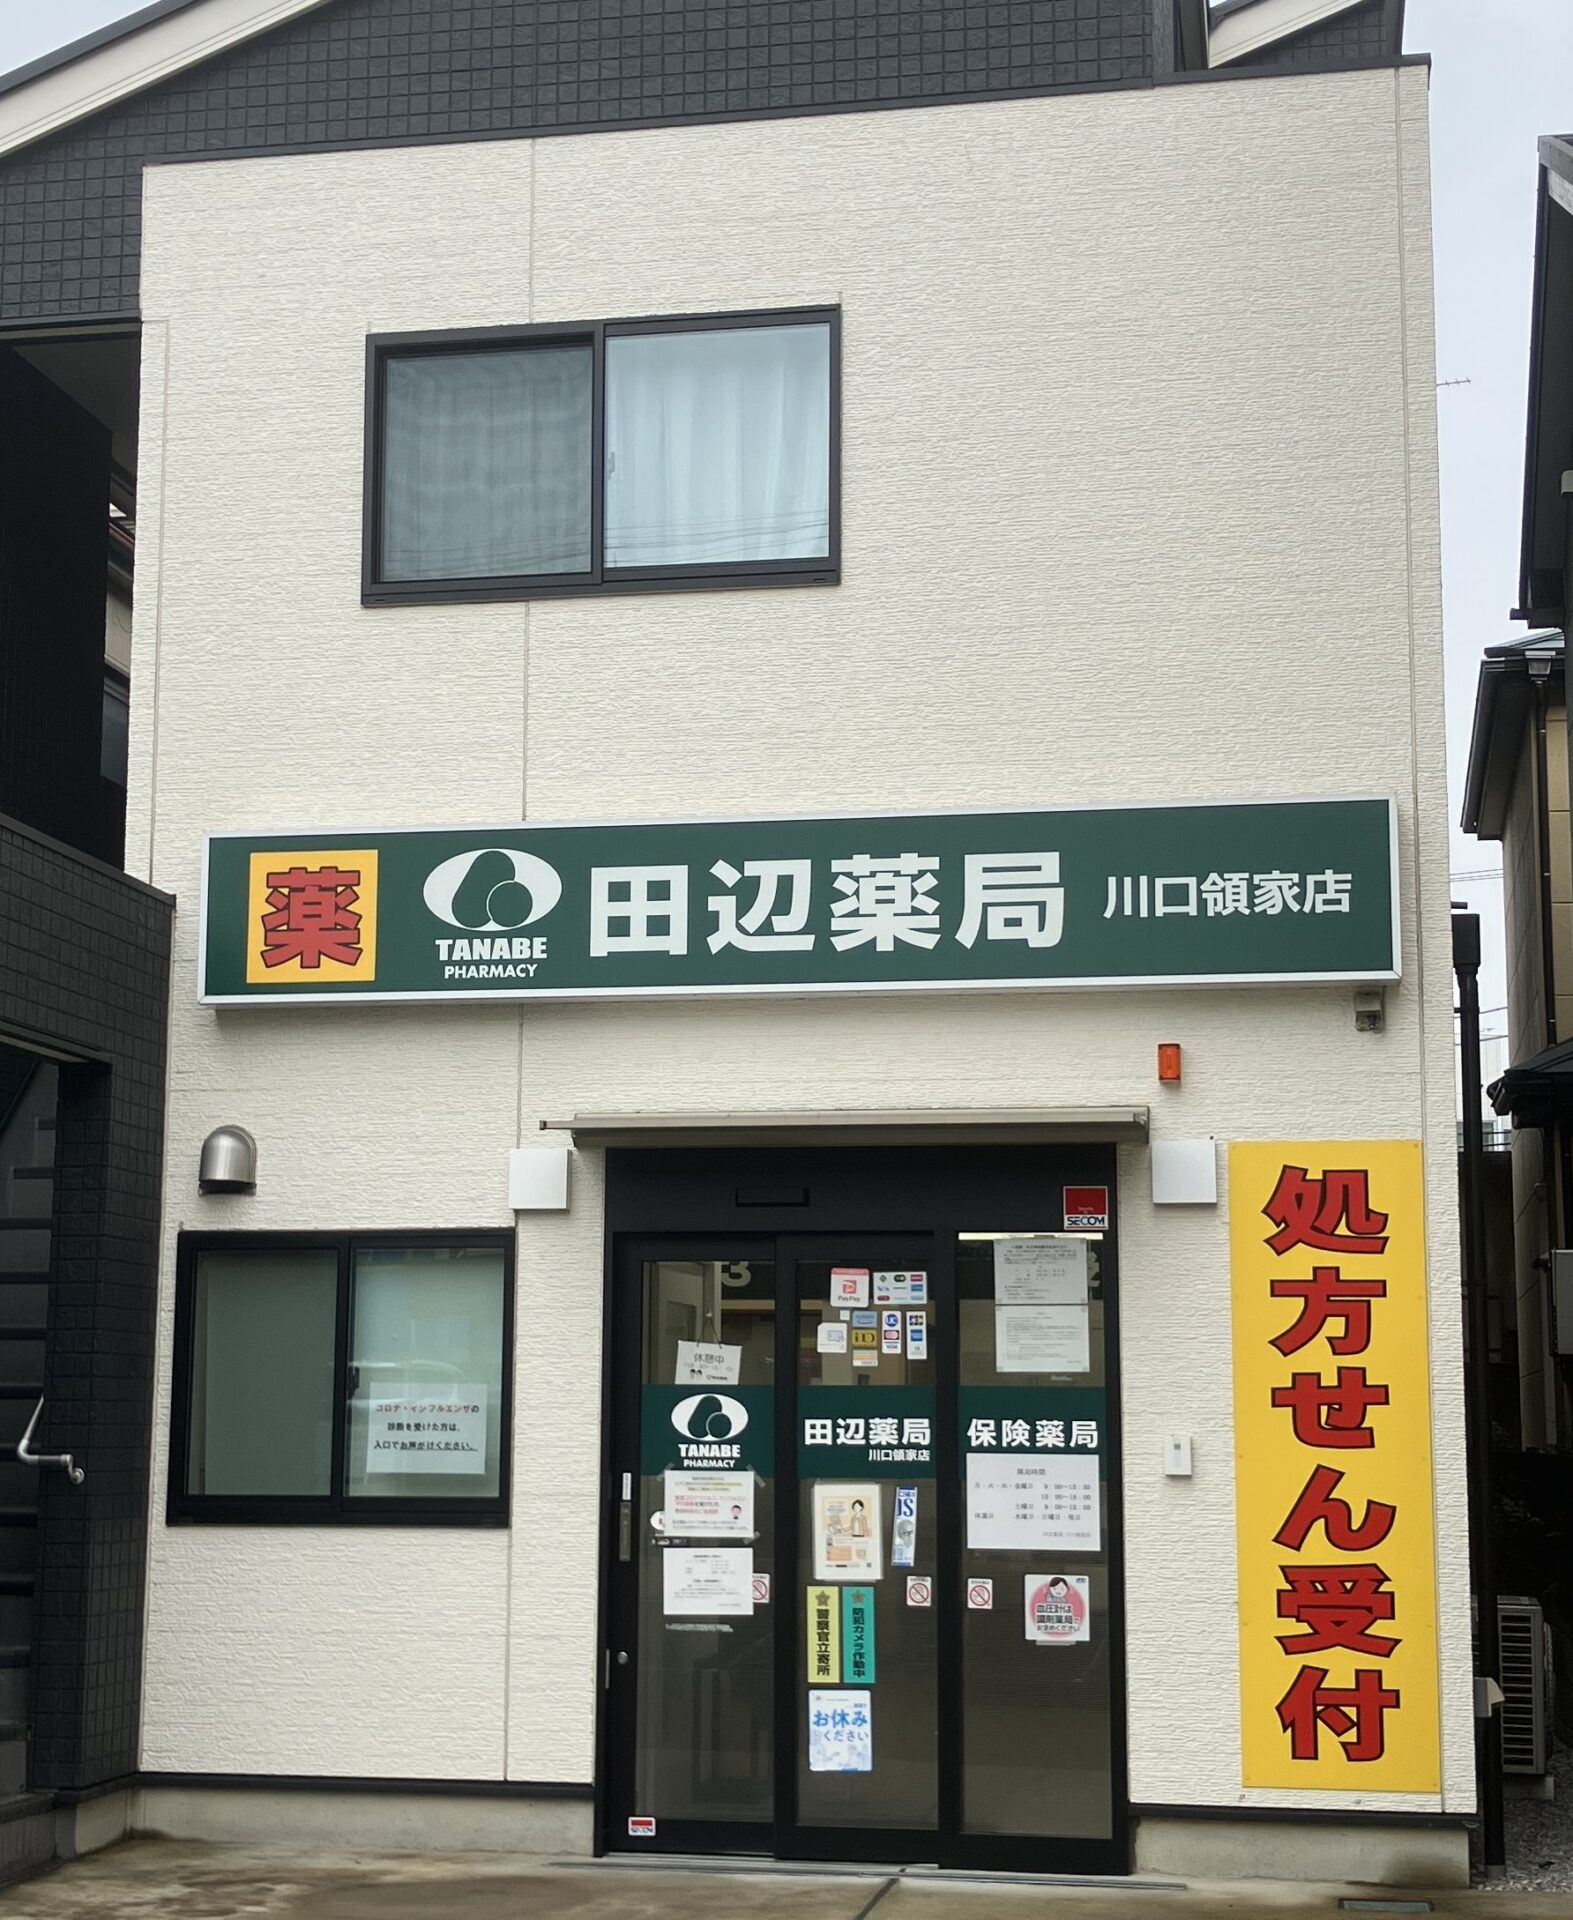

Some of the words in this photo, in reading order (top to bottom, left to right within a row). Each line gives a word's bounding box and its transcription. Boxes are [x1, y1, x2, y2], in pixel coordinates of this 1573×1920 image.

[1102, 869, 1352, 919] 川口領家店
[589, 851, 1065, 957] 田辺薬局
[261, 866, 363, 969] 薬
[435, 936, 547, 961] TANABE
[444, 963, 538, 980] PHARMACY
[1067, 1216, 1105, 1226] SECOM
[694, 1353, 724, 1364] 休憩中
[376, 1405, 480, 1413] コロナ・インフルエンザの
[387, 1422, 460, 1432] 診断を受けた方は、
[804, 1417, 931, 1446] 田辺薬局
[967, 1418, 1098, 1449] 保険薬局
[678, 1443, 740, 1458] TANABE
[868, 1448, 930, 1461] 川口領家店
[683, 1459, 736, 1468] PHARMACY
[1261, 1163, 1403, 1763] 処方せん受付
[1036, 1604, 1072, 1614] 血圧計は
[816, 1608, 830, 1676] 警察官立寄所
[852, 1607, 865, 1678] 防犯カメラ作動中
[813, 1709, 868, 1729] お休み
[823, 1730, 869, 1742] ください
